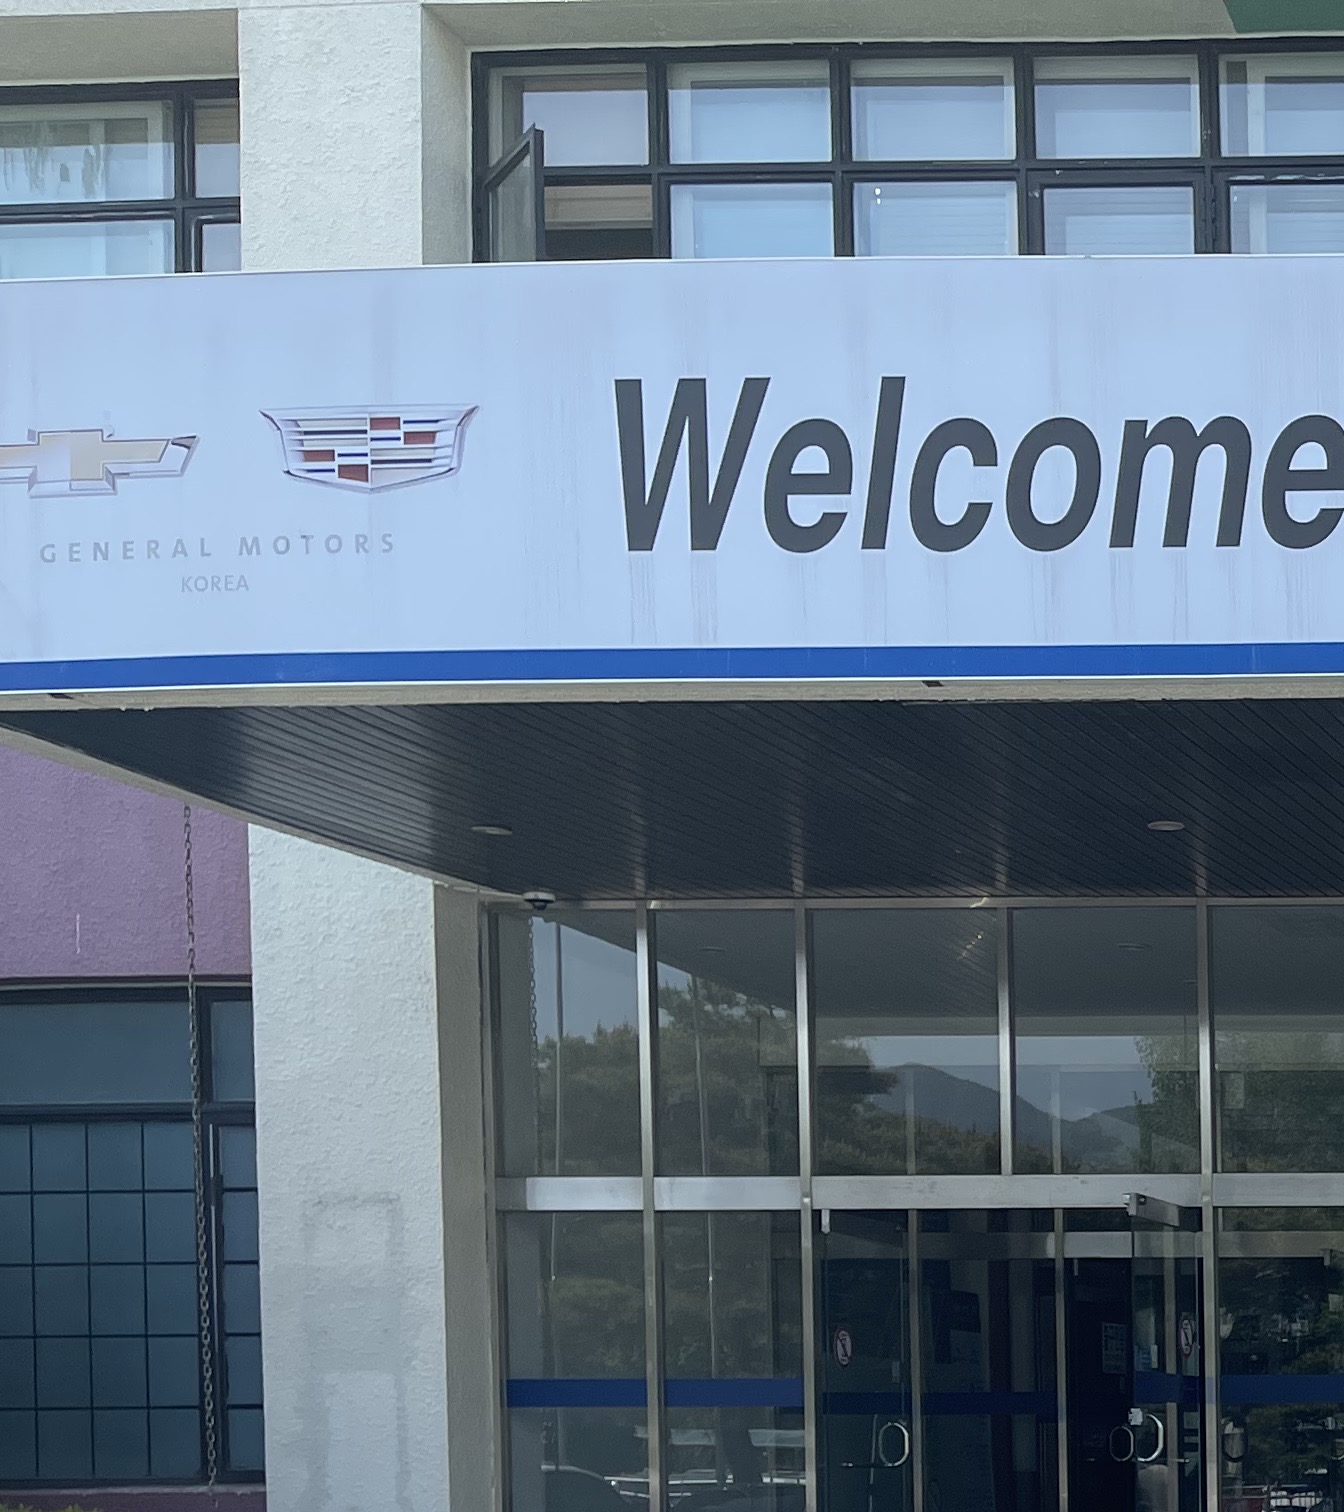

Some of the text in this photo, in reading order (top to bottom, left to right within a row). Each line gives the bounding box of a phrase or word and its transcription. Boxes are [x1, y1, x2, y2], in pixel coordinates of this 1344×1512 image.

[39, 533, 395, 563] GENERAL MOTORS
[181, 574, 249, 593] KOREA
